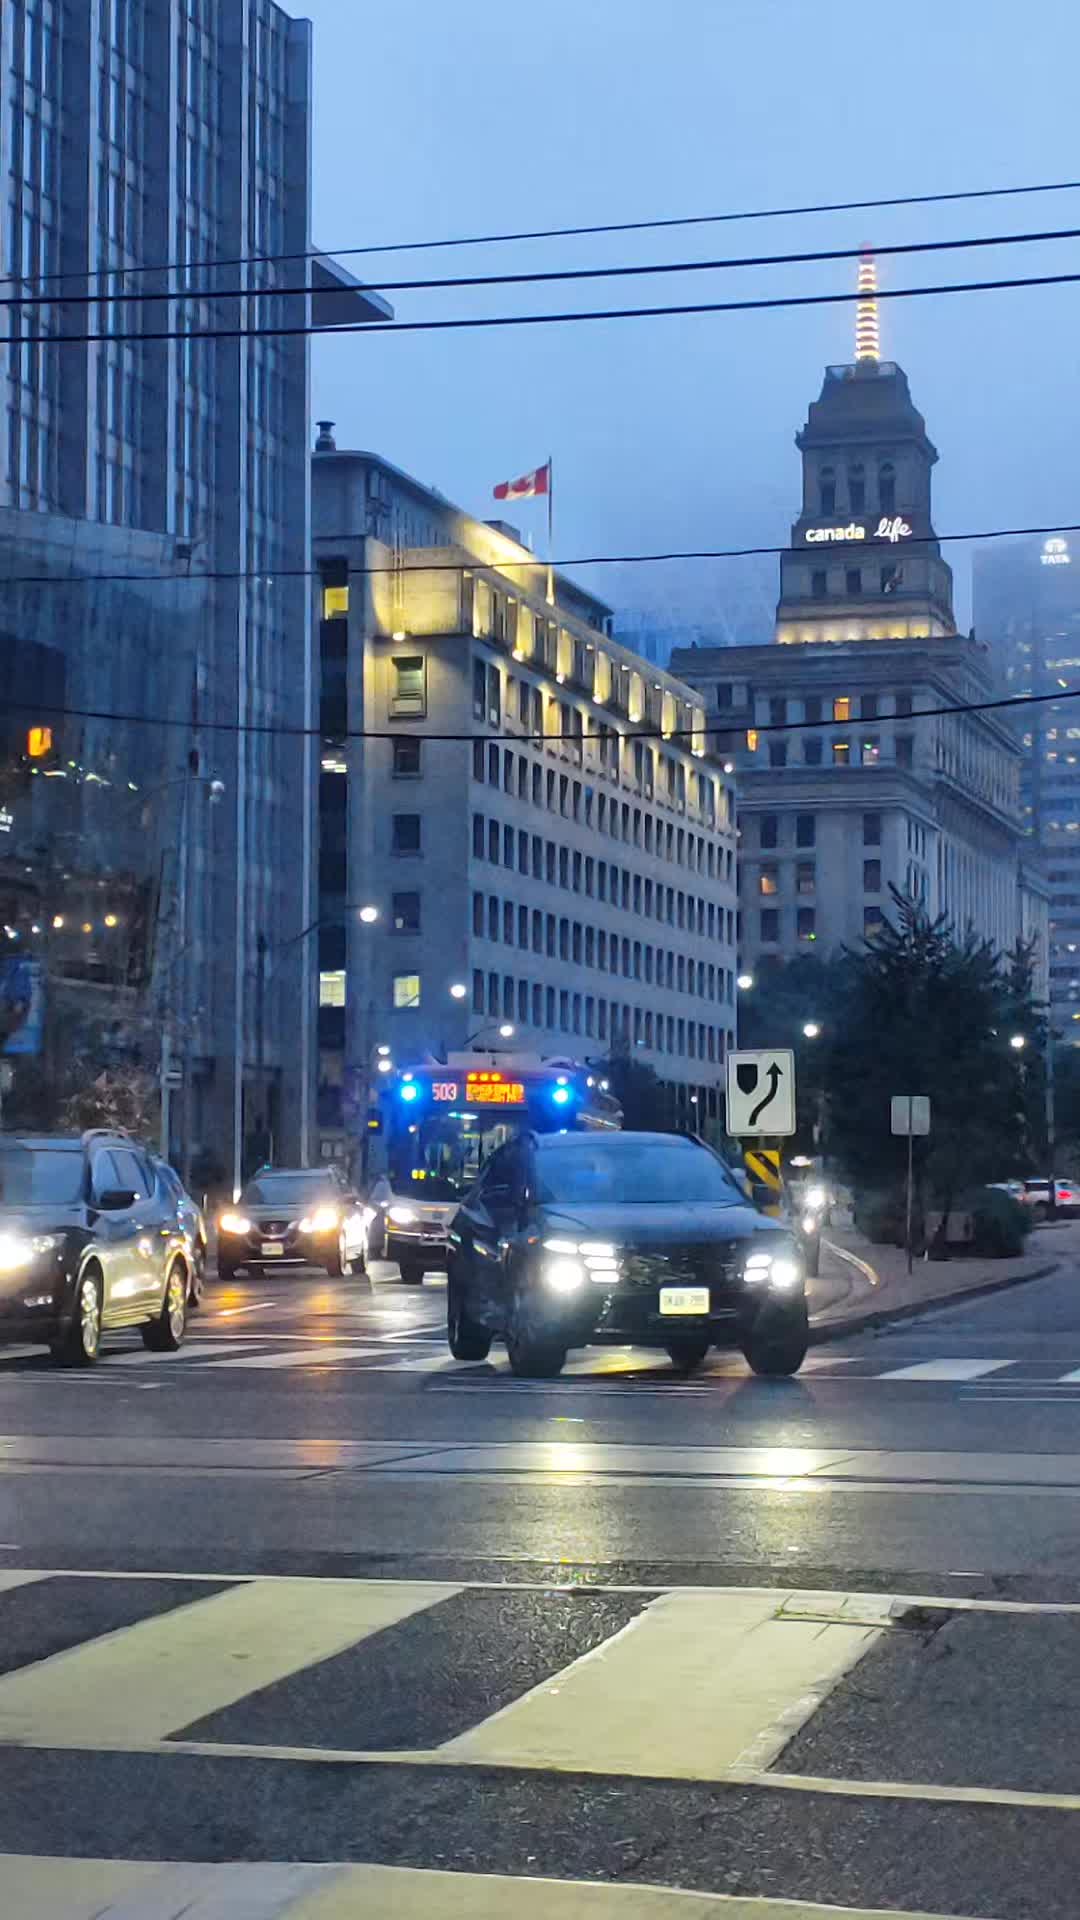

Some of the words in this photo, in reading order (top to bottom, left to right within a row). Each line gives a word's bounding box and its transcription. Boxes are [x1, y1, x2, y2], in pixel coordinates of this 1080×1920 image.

[805, 523, 865, 542] canada
[873, 517, 912, 543] life
[1040, 554, 1070, 566] TATA
[432, 1083, 457, 1101] 503
